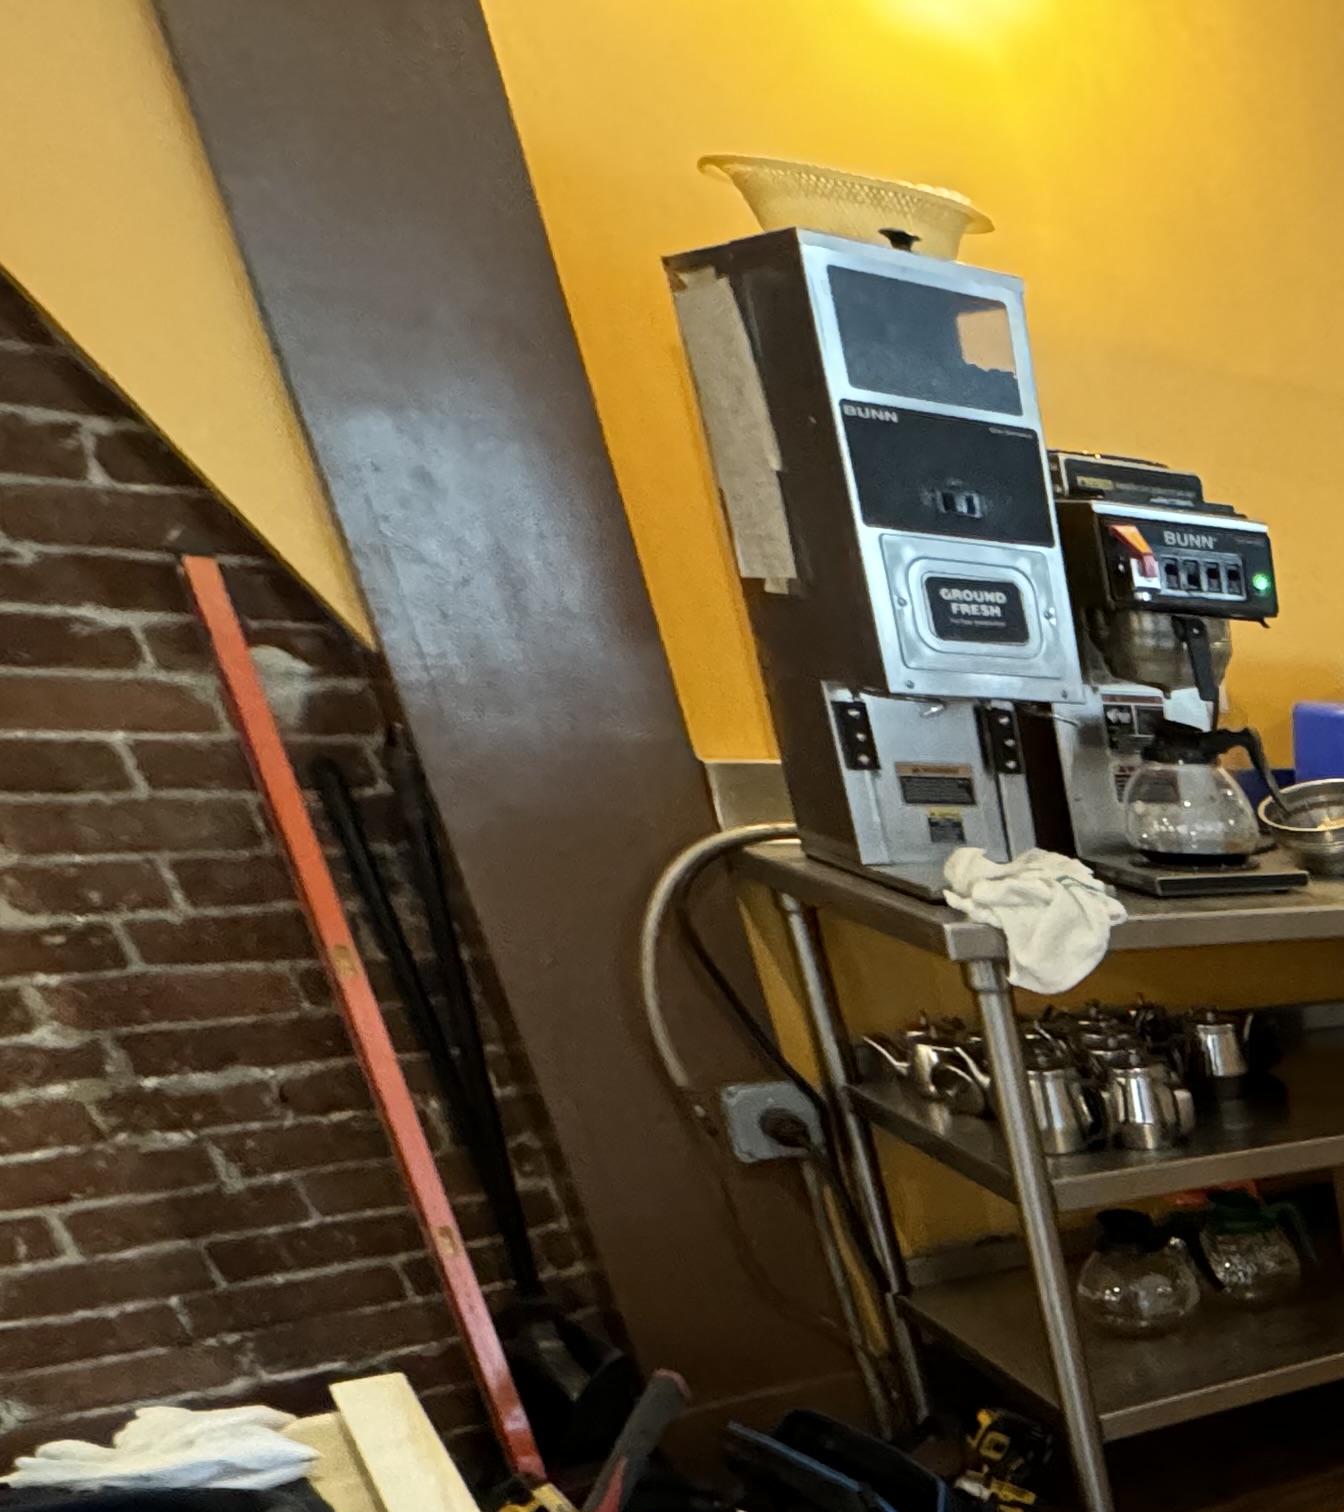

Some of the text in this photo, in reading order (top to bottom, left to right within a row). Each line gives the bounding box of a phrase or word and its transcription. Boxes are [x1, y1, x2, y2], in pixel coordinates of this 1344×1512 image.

[842, 404, 898, 424] BUNN
[1163, 530, 1215, 550] BUNN
[939, 587, 1007, 604] GROUND
[950, 602, 1002, 617] FRESH
